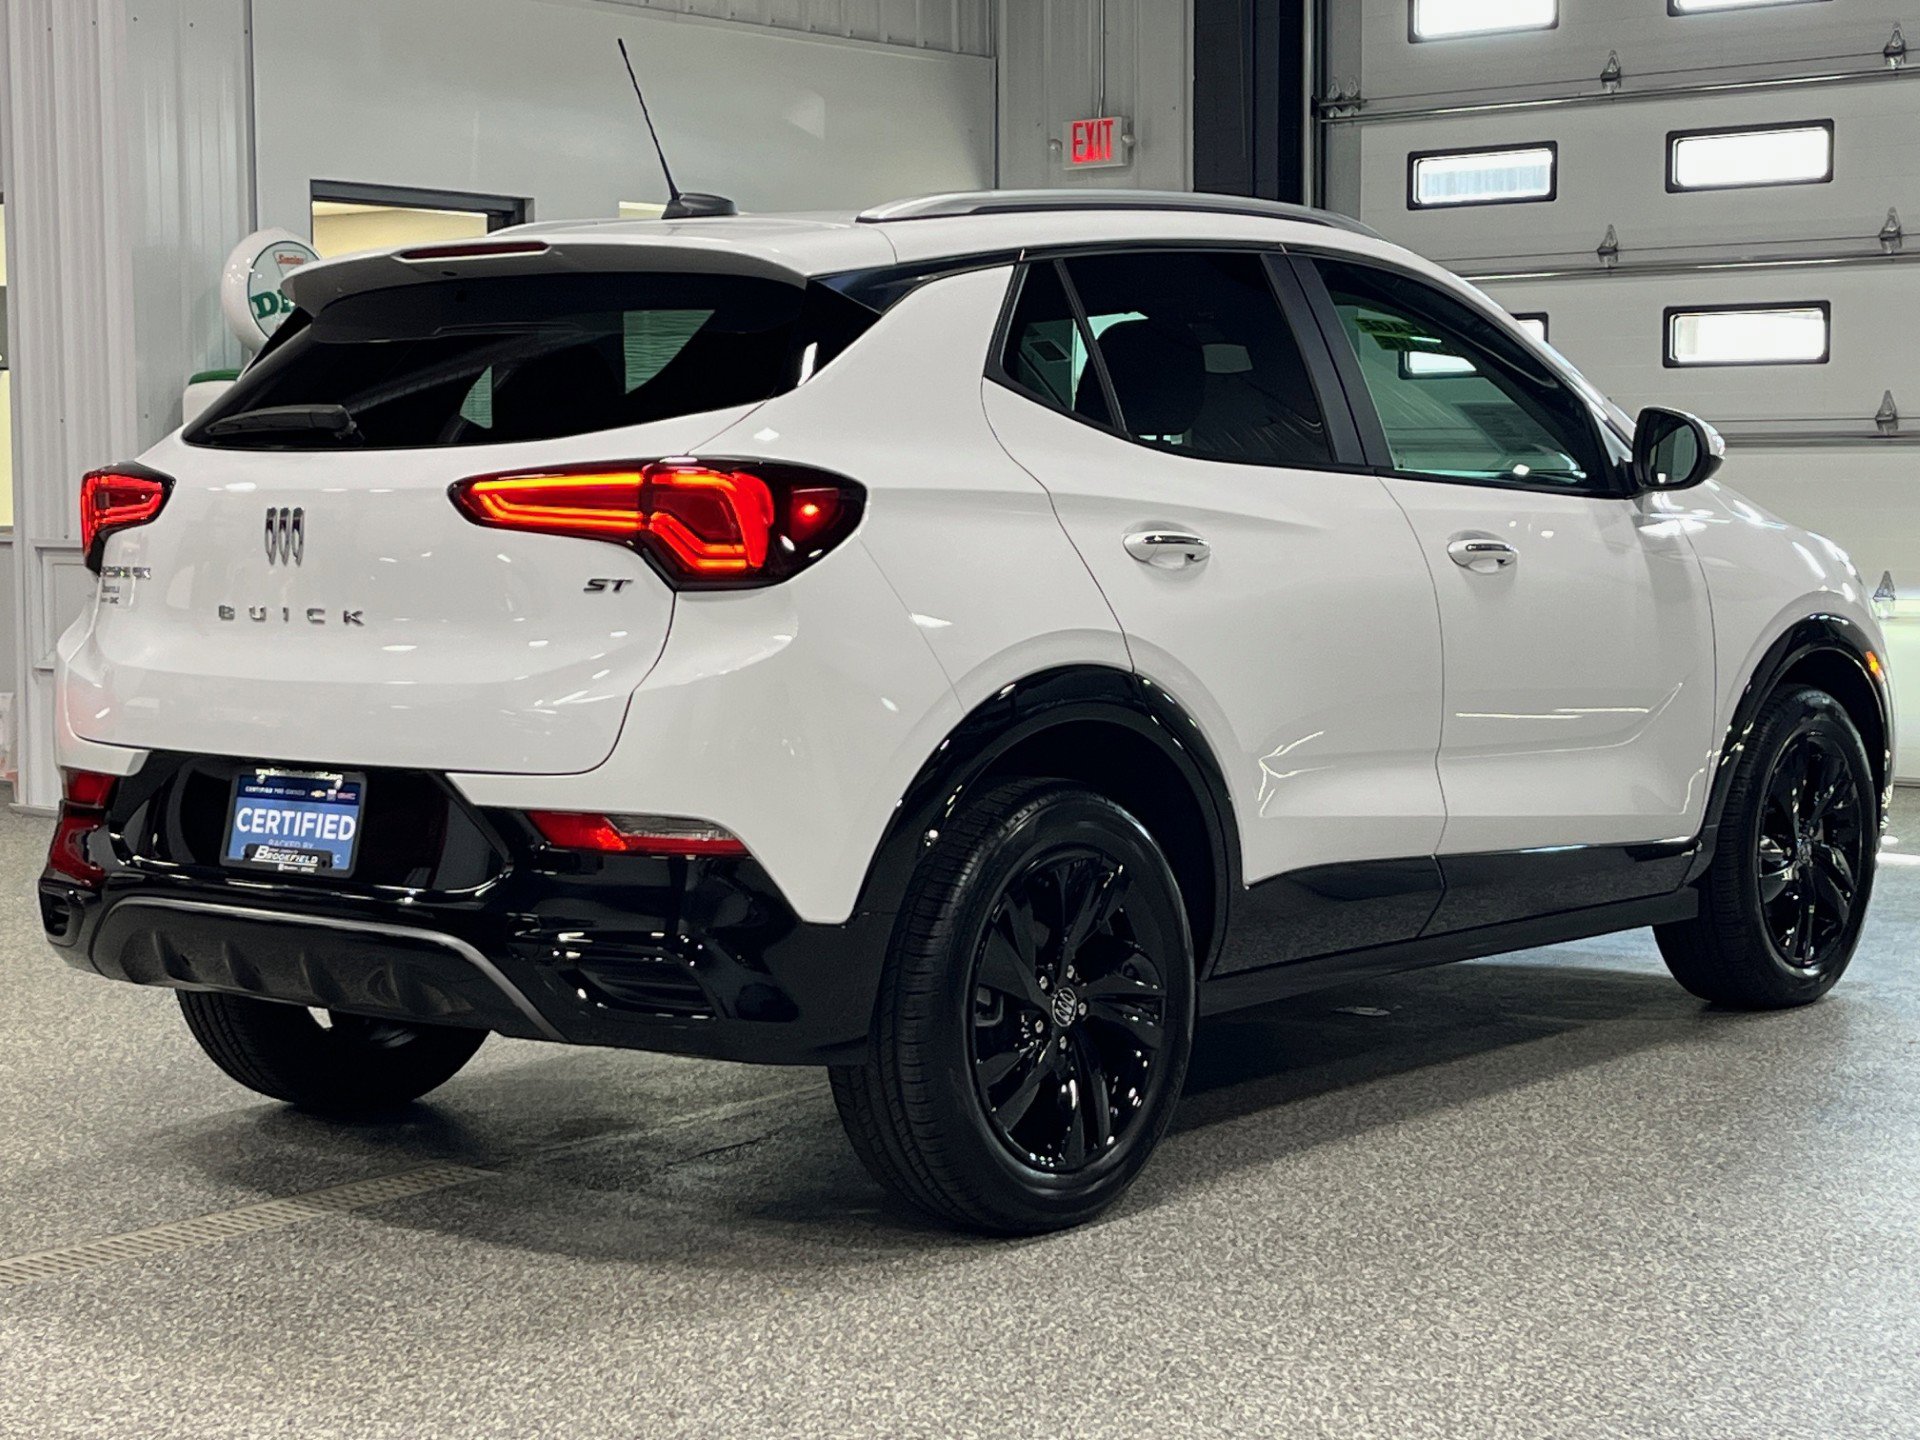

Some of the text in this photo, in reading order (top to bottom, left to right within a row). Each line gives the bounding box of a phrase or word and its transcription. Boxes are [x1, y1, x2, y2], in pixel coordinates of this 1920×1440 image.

[1072, 120, 1113, 163] EXIT
[583, 578, 633, 593] ST
[217, 604, 365, 627] BUICK
[236, 807, 356, 841] CERTIFIED
